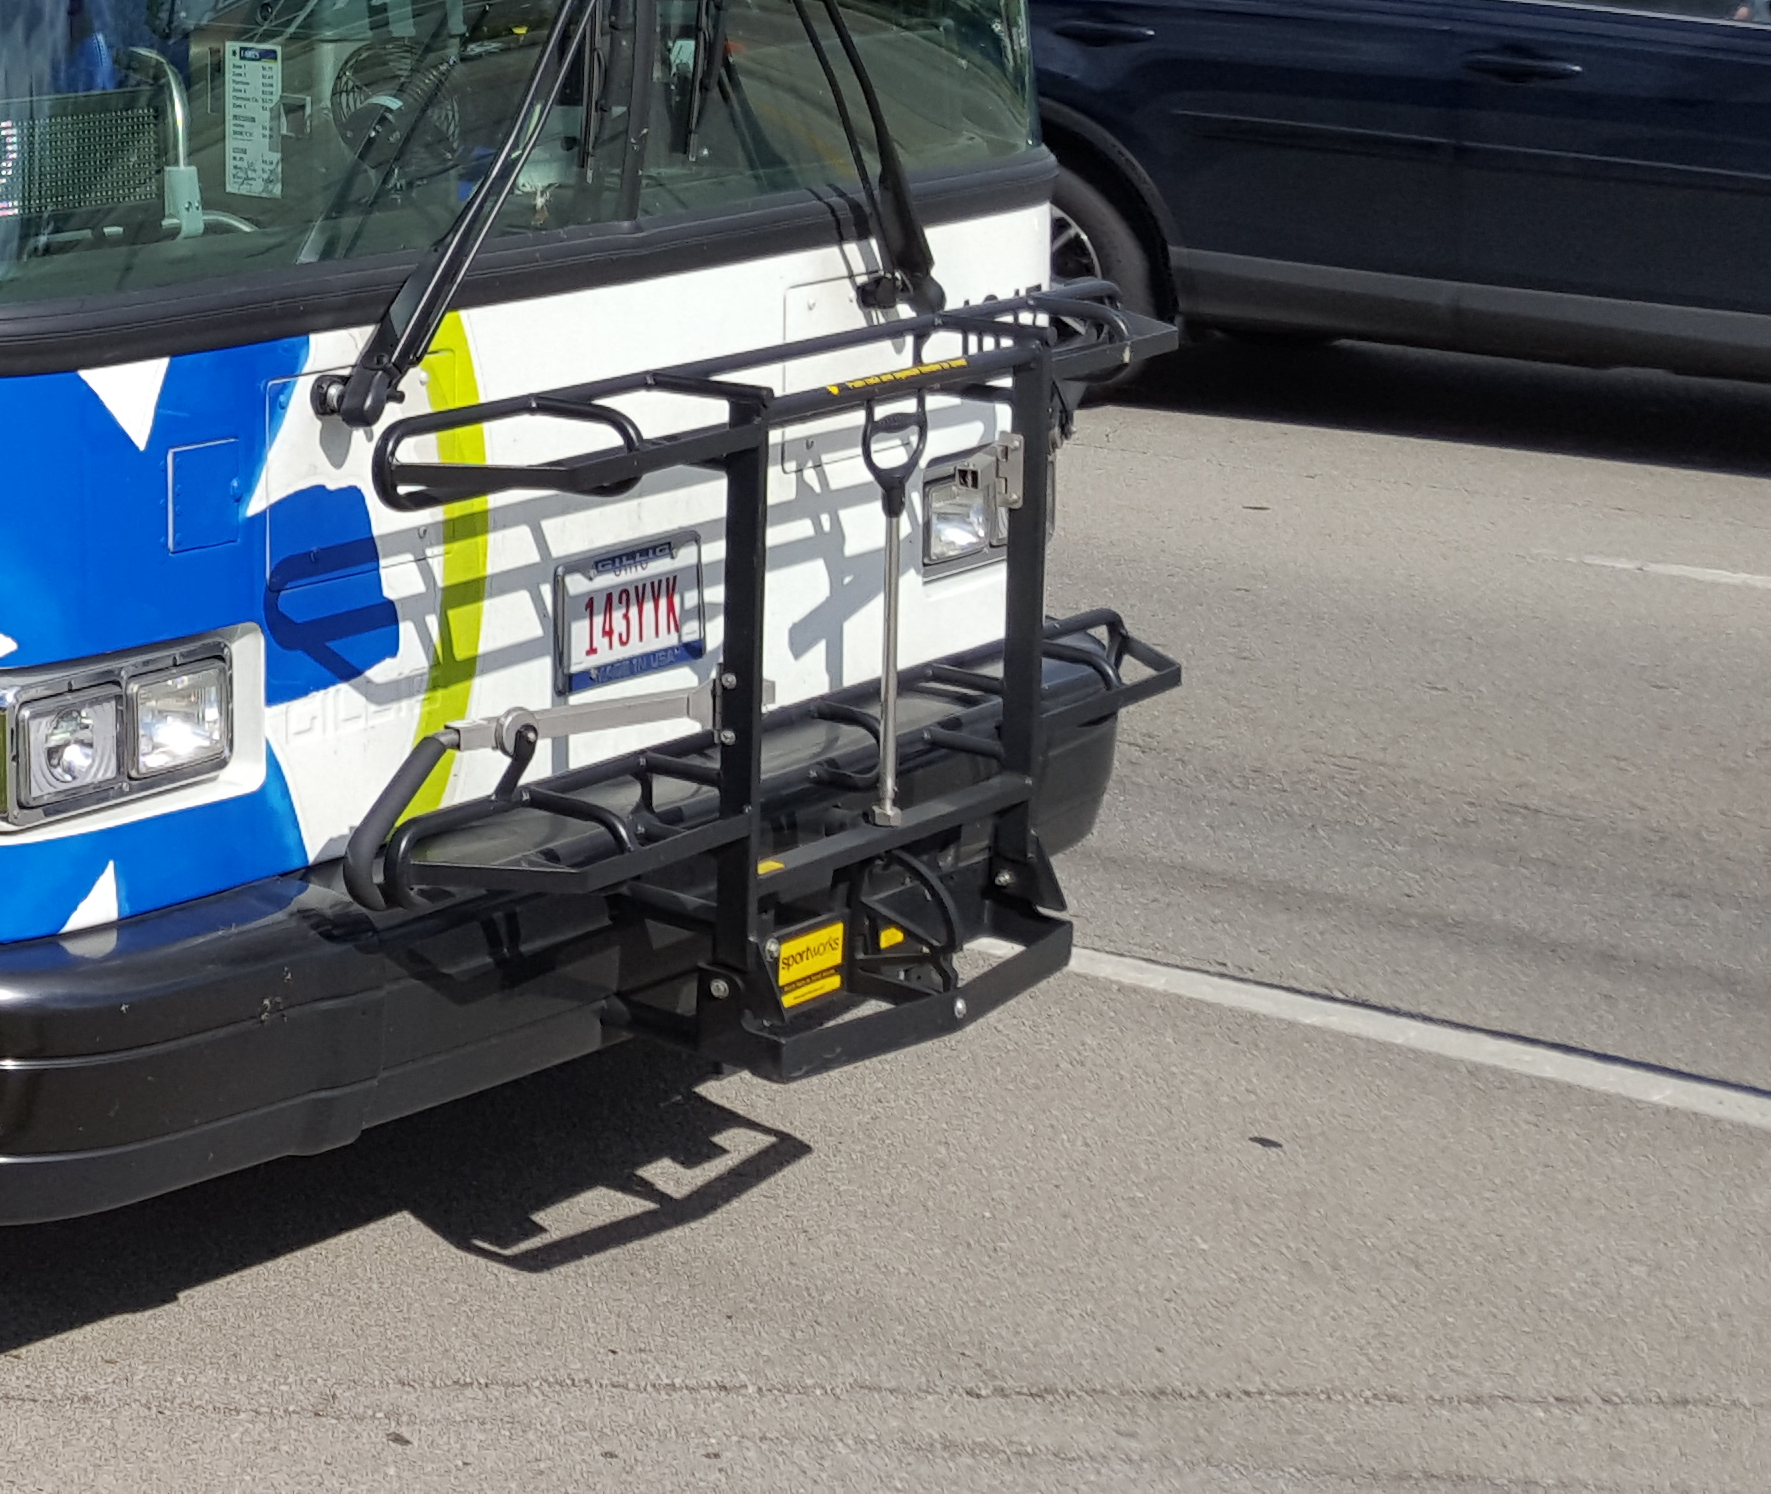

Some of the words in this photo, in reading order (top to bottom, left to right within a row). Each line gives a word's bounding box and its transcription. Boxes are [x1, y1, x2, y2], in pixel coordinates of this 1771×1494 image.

[598, 543, 671, 572] GILLIG
[584, 574, 680, 657] 143YYK
[781, 936, 840, 973] sportworks
